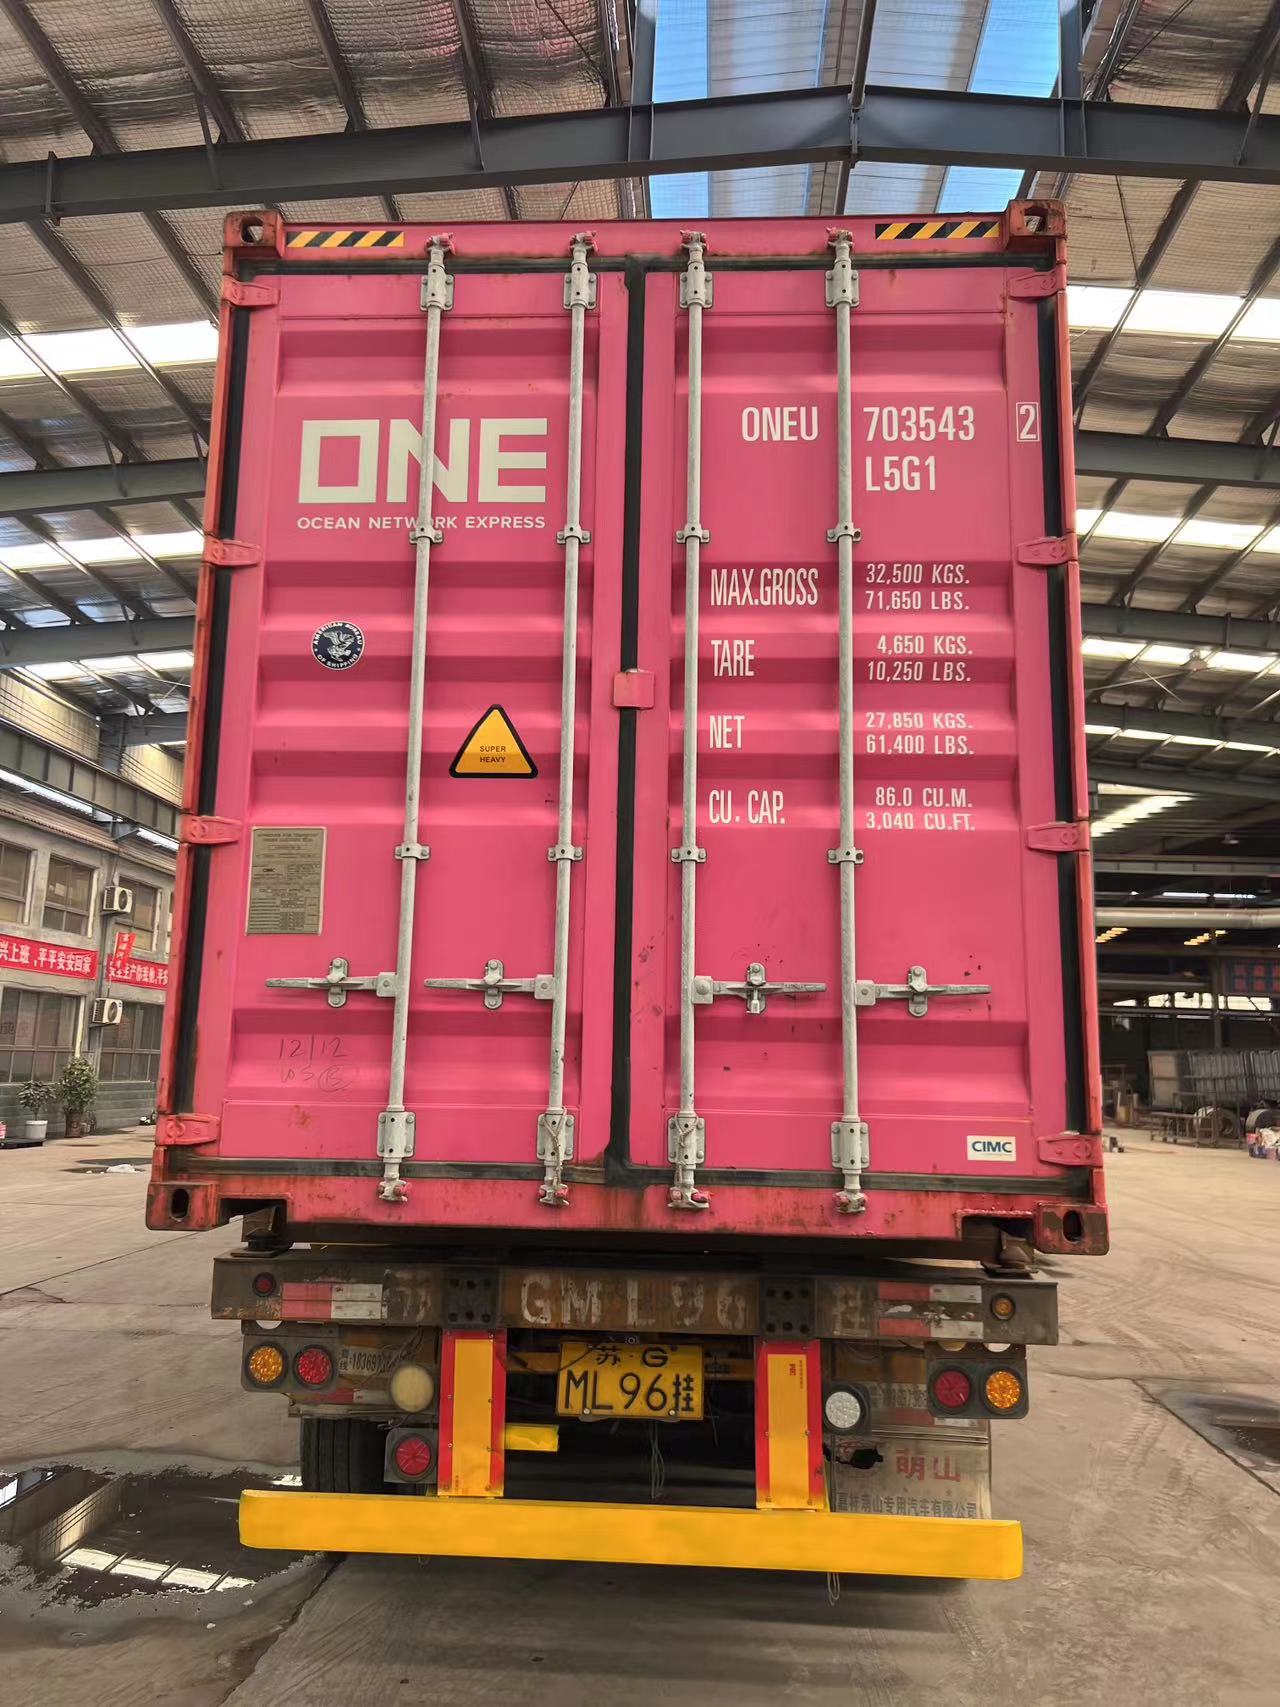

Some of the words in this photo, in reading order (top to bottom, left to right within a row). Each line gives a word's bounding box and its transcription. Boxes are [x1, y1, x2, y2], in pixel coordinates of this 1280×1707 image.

[741, 406, 819, 442] ONEU
[863, 405, 975, 442] 703543
[1019, 404, 1037, 440] 2
[298, 418, 547, 503] ONE
[865, 455, 937, 491] L5G1
[297, 516, 360, 529] OCEAN
[369, 516, 458, 529] NETWRK
[465, 516, 546, 529] EXPRESS
[710, 568, 819, 606] MAX.GROSS
[866, 564, 923, 586] 32,500
[931, 563, 970, 585] KGS.
[865, 590, 922, 611] 71,650
[931, 590, 970, 610] LBS.
[710, 639, 755, 677] TARE
[877, 635, 924, 657] 4,650
[934, 635, 973, 655] KGS.
[868, 661, 923, 683] 10,250
[931, 661, 971, 682] LBS.
[709, 714, 745, 749] NET
[865, 712, 924, 730] 27,850
[932, 712, 974, 730] KGS.
[866, 735, 925, 756] 61,400
[934, 735, 974, 755] LBS.
[479, 745, 507, 753] SUPER
[709, 789, 741, 824] CU.
[747, 789, 786, 825] CAP.
[875, 787, 913, 807] 86.0
[922, 787, 973, 808] CU.M.
[865, 812, 914, 830] 3,040
[971, 1140, 1013, 1153] CIMC
[565, 1370, 695, 1412] ML96挂
